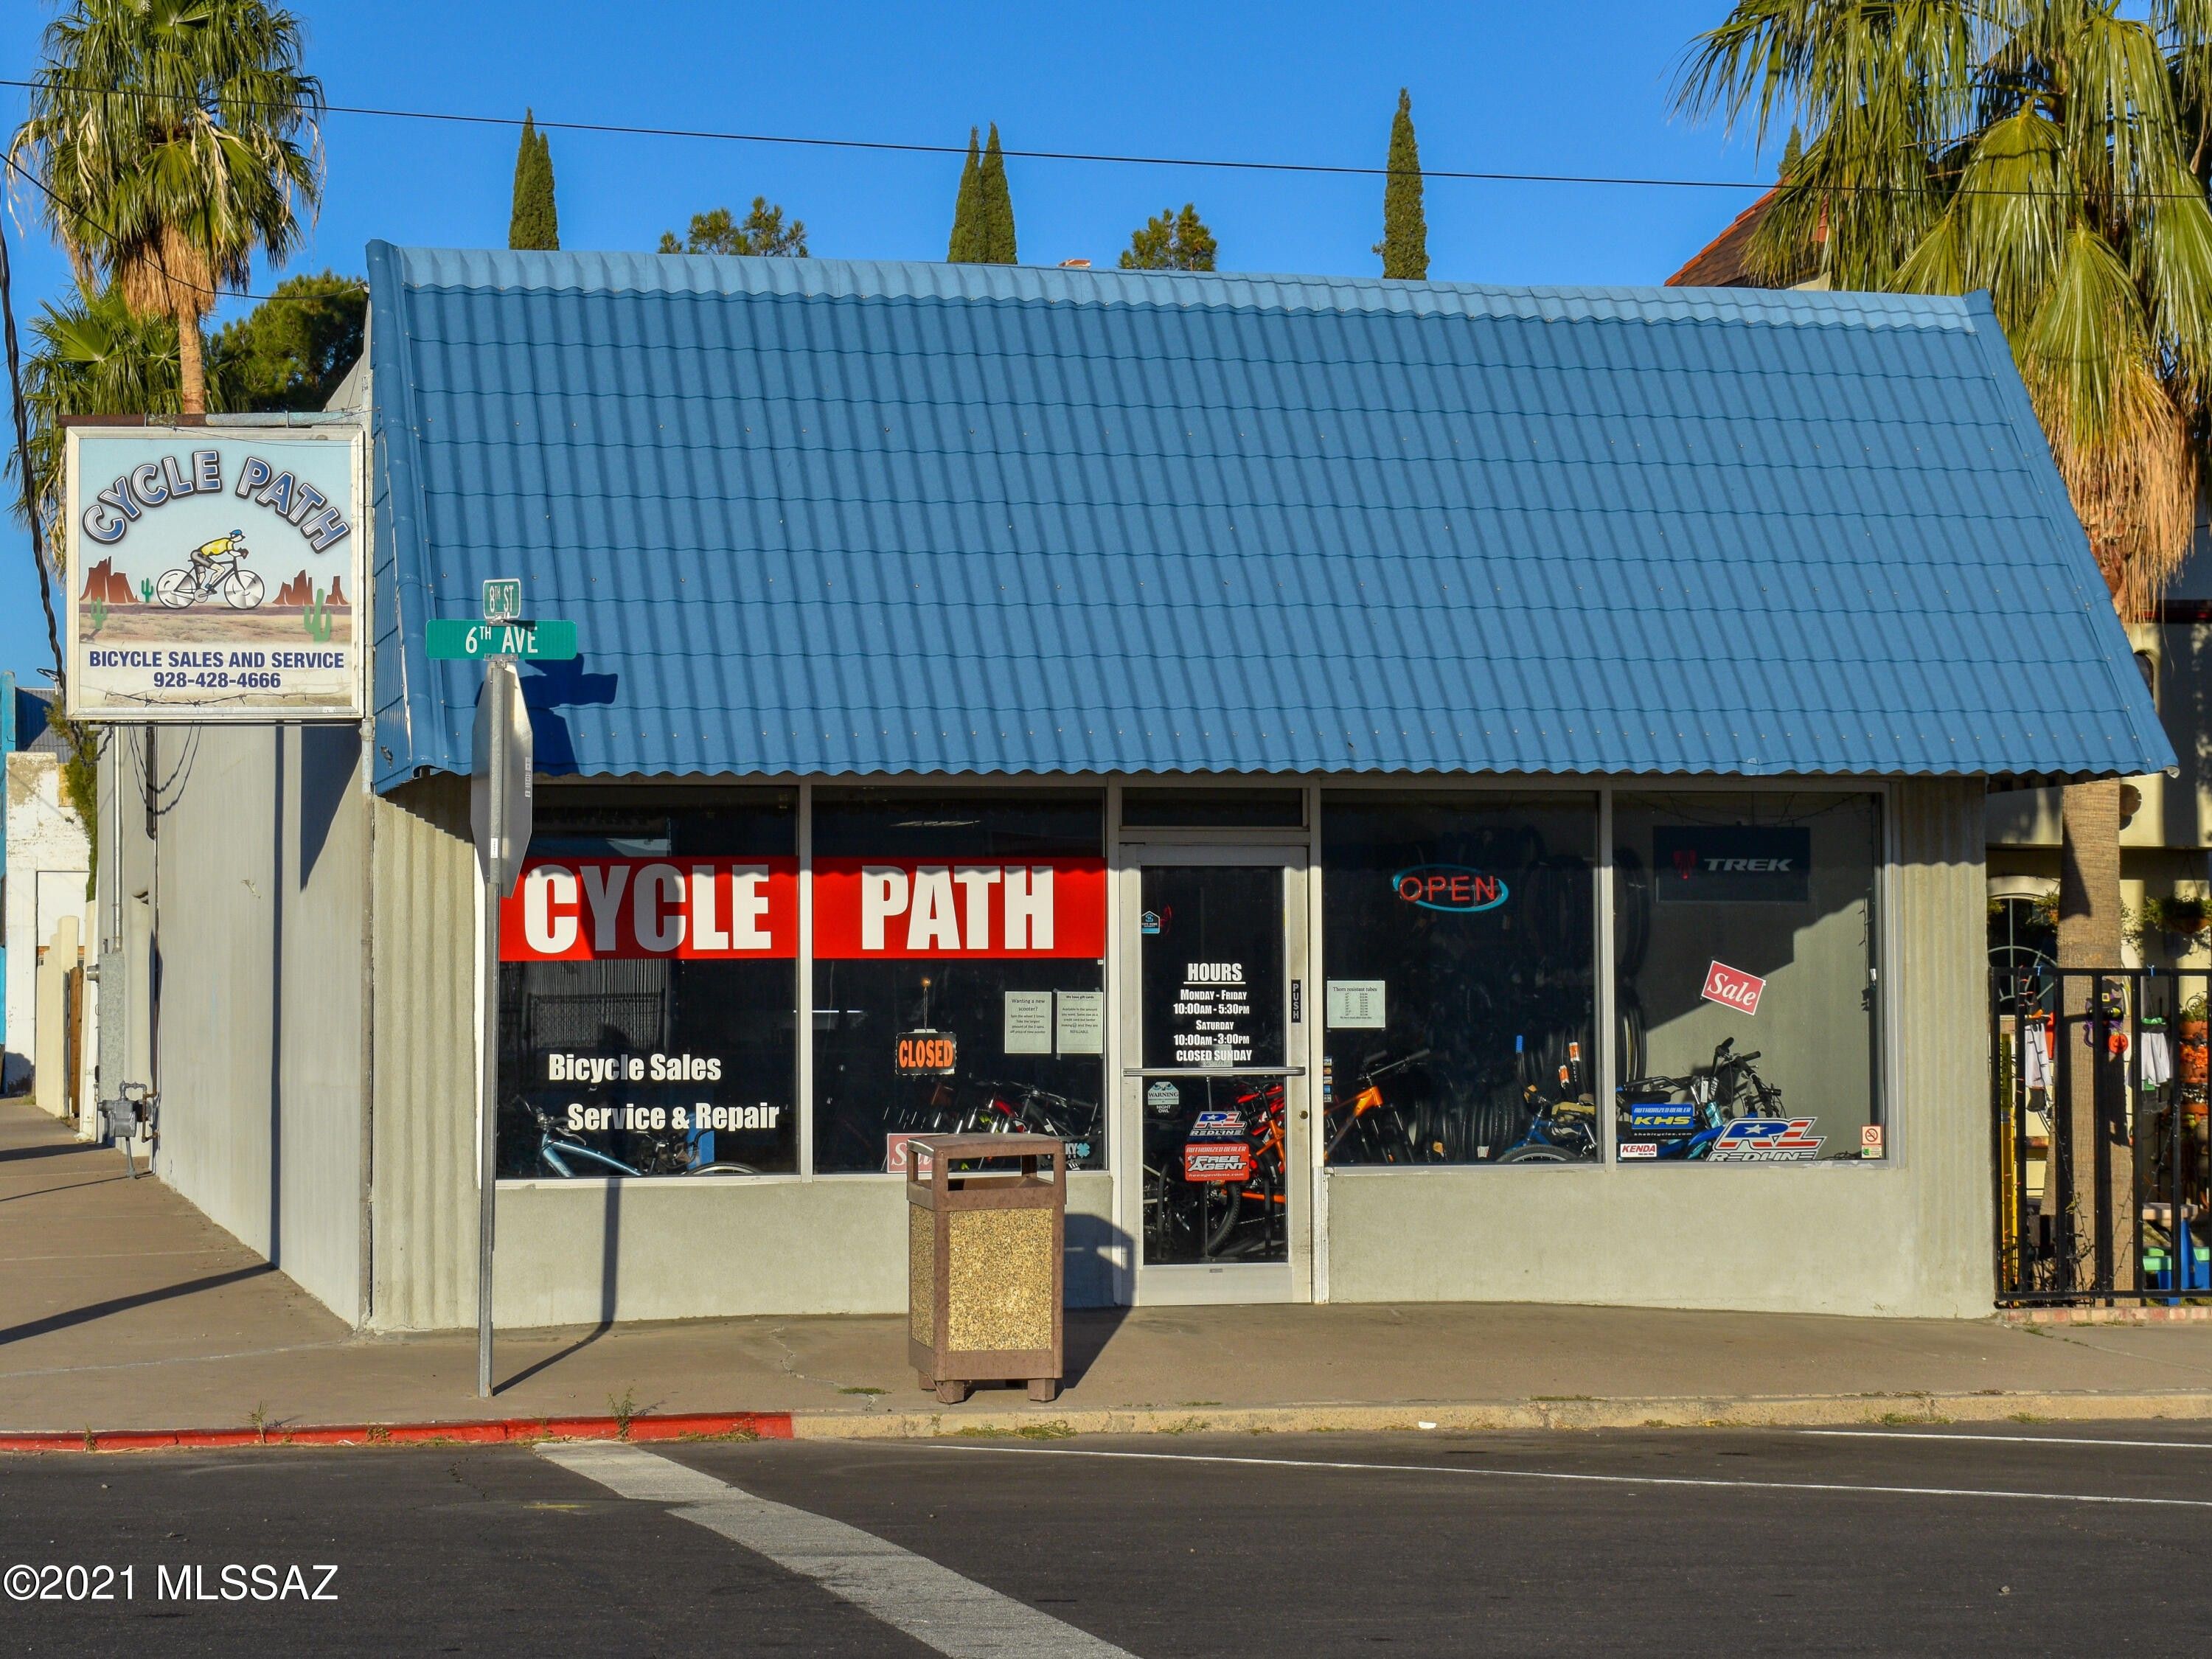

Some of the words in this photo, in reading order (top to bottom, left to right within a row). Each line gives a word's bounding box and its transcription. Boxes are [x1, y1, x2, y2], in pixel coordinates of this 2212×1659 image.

[83, 451, 221, 544] CYCLE
[235, 456, 351, 553] PATH
[490, 585, 501, 613] 8TH
[504, 585, 514, 612] ST
[465, 626, 491, 653] 6TH
[501, 626, 538, 653] AVE
[89, 651, 162, 667] BICYCLE
[168, 651, 223, 667] SALES
[229, 652, 265, 667] AND
[271, 652, 344, 668] SERVICE
[153, 672, 281, 688] 928-428-4666
[1704, 858, 1794, 872] TREK
[1399, 875, 1496, 902] OPEN
[524, 863, 772, 953] CYCLE
[862, 865, 1054, 950] PATH
[1188, 963, 1242, 981] HOURS
[1180, 990, 1214, 1001] MONDAY
[1221, 990, 1247, 1001] FRIDAY
[1707, 972, 1757, 1006] Sale
[1173, 1004, 1212, 1015] 10:00AM
[1218, 1004, 1250, 1015] 5:30PM
[1196, 1020, 1234, 1030] SATURDAY
[1174, 1034, 1212, 1045] 10:00AM
[899, 1040, 953, 1068] CLOSED
[1176, 1050, 1212, 1061] CLOSED
[1214, 1050, 1252, 1061] SUNDAY
[549, 1054, 644, 1083] Bicycle
[650, 1054, 721, 1080] Sales
[568, 1102, 666, 1130] Service
[672, 1106, 689, 1130] &
[695, 1102, 779, 1132] Repair
[1634, 1116, 1691, 1125] KHS
[1622, 1145, 1656, 1153] KENDA
[1708, 1152, 1816, 1162] REDLINE
[1188, 1163, 1247, 1172] AGENT
